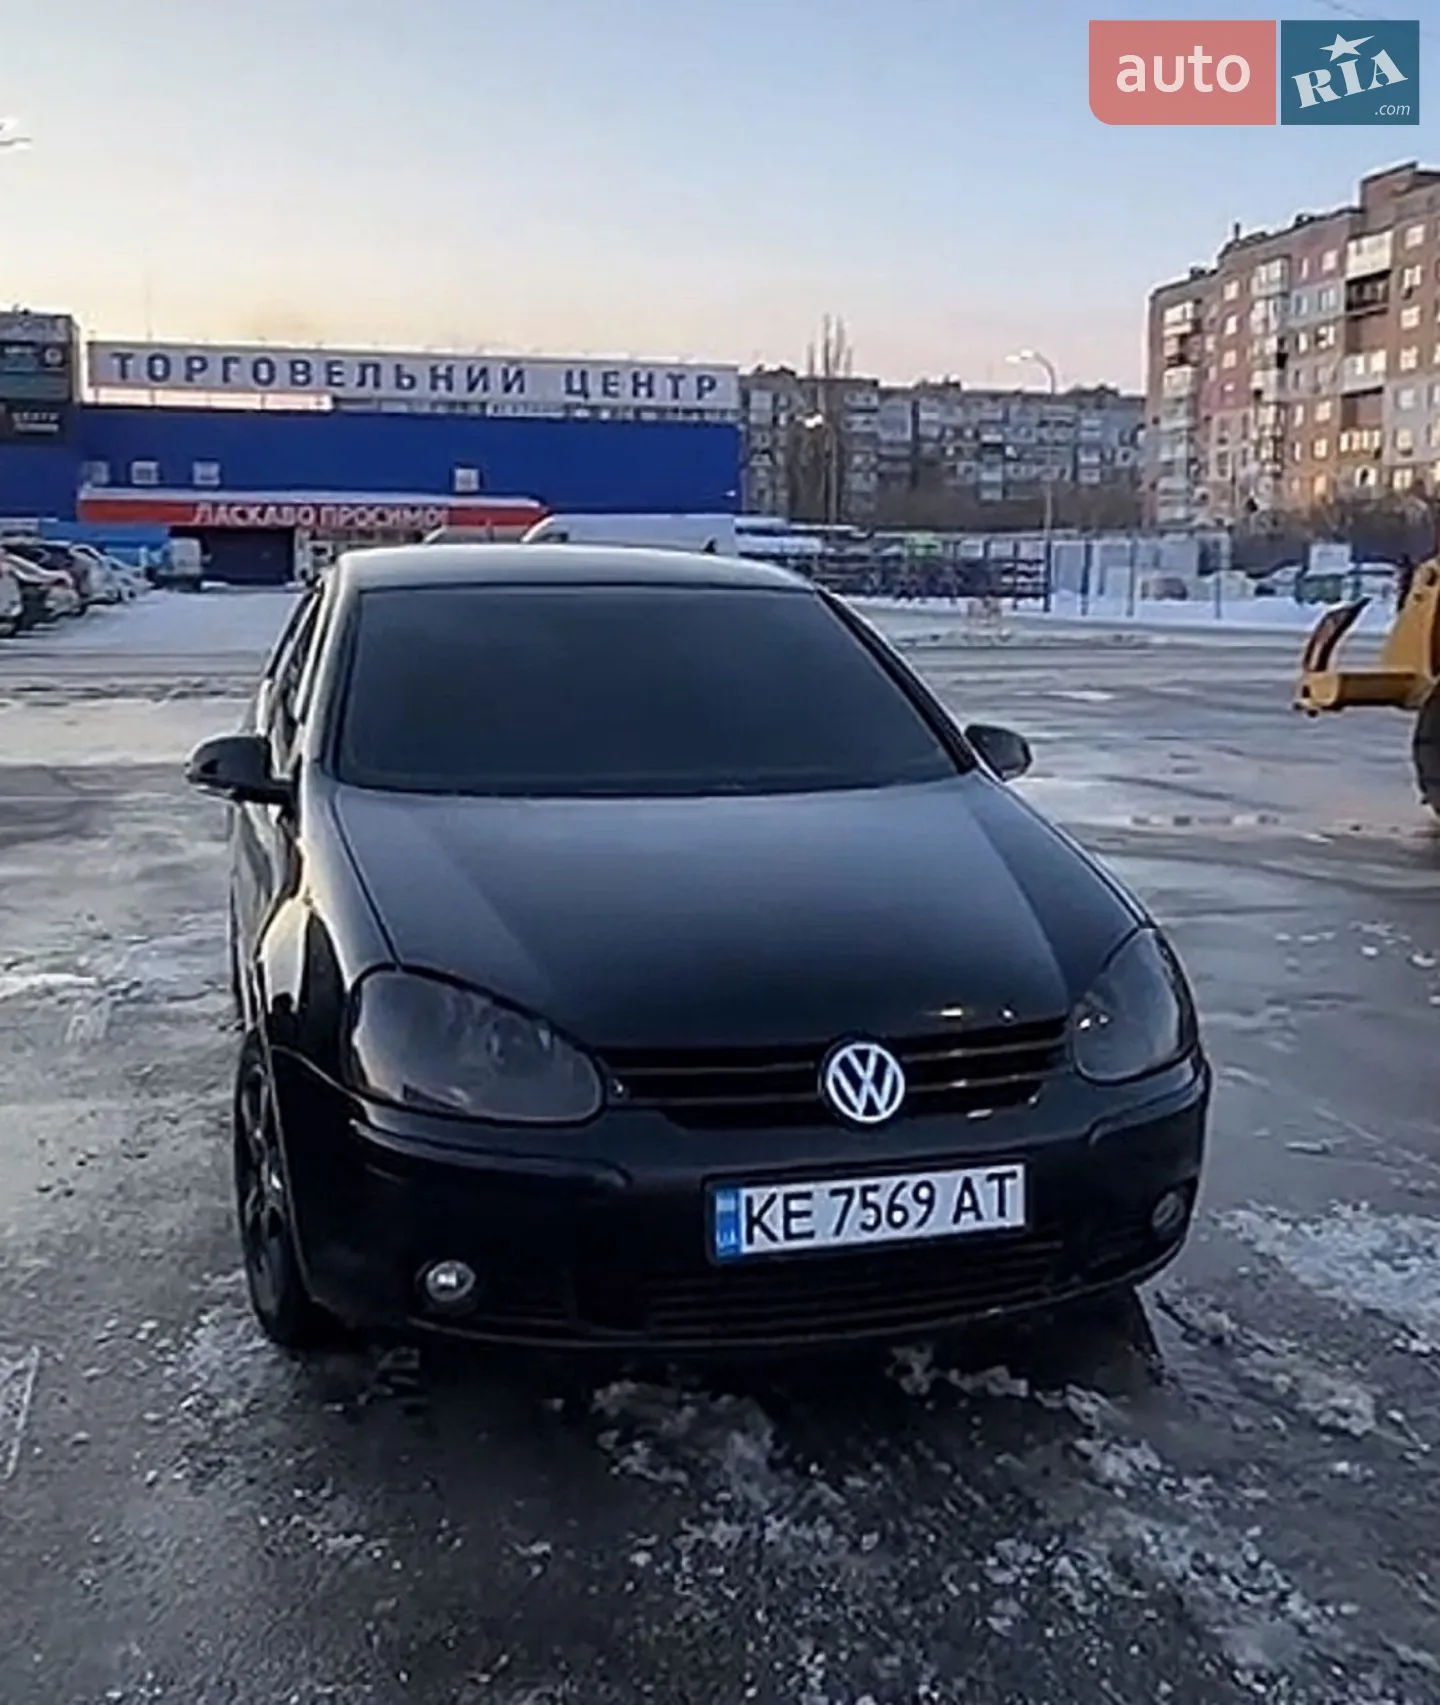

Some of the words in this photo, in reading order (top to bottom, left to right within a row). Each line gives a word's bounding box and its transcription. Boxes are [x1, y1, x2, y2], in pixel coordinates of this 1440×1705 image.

[110, 352, 526, 395] ТОРГОВЕЛЬНИЙ
[564, 369, 718, 400] ЦЕНТР
[192, 503, 318, 528] ЛАСКАВО
[745, 1191, 816, 1246] KE
[828, 1179, 937, 1238] 7569
[952, 1170, 1018, 1226] AT
